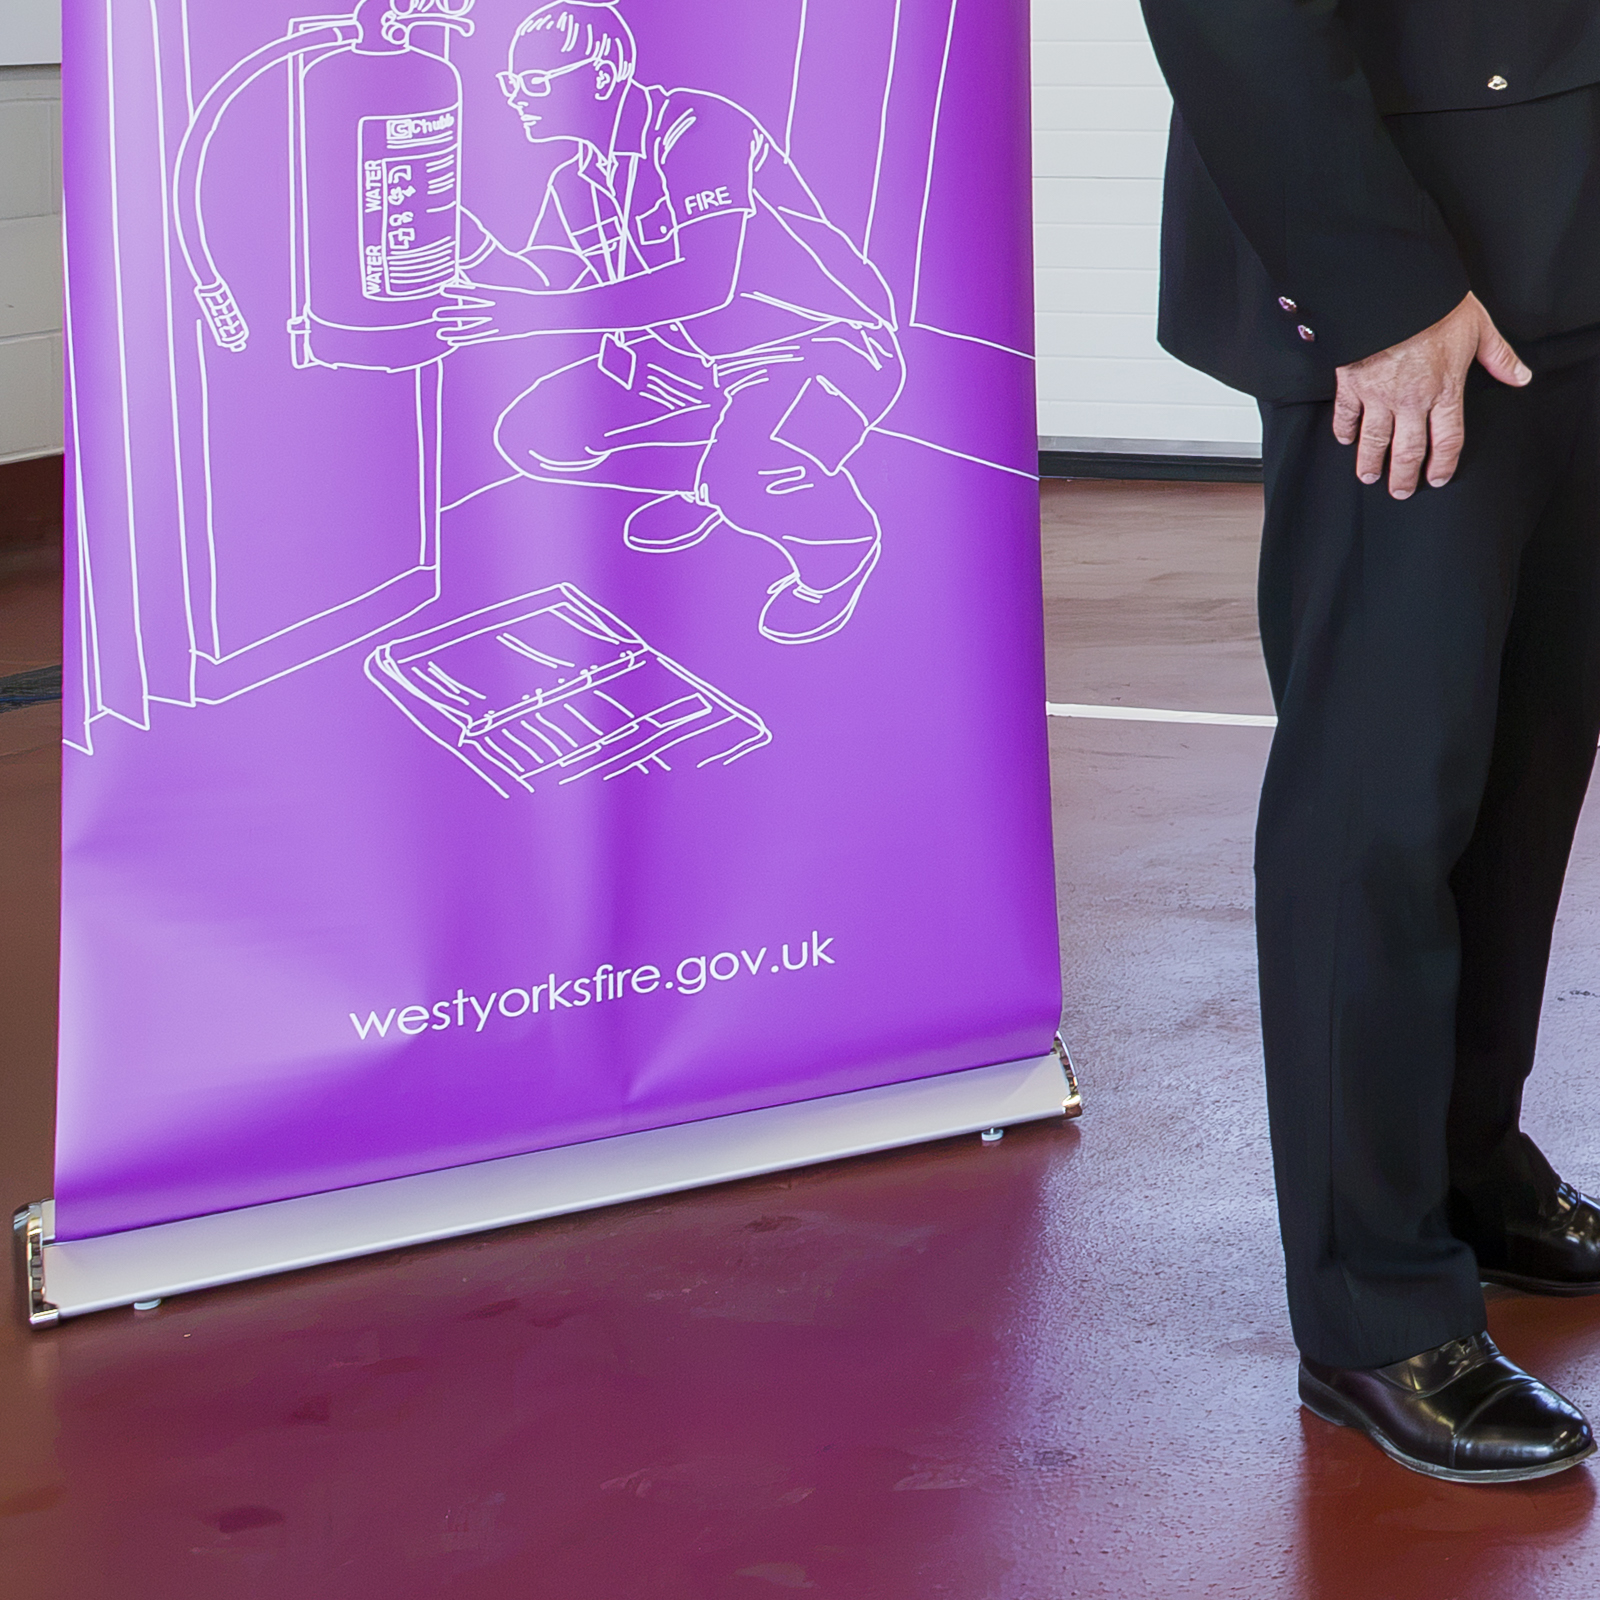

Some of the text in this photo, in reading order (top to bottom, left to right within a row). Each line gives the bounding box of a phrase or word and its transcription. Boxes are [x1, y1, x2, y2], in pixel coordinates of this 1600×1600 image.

[365, 159, 382, 213] WATER
[684, 185, 733, 216] FIRE
[366, 245, 383, 295] WATER
[349, 930, 836, 1040] westyorksfire.gov.uk
